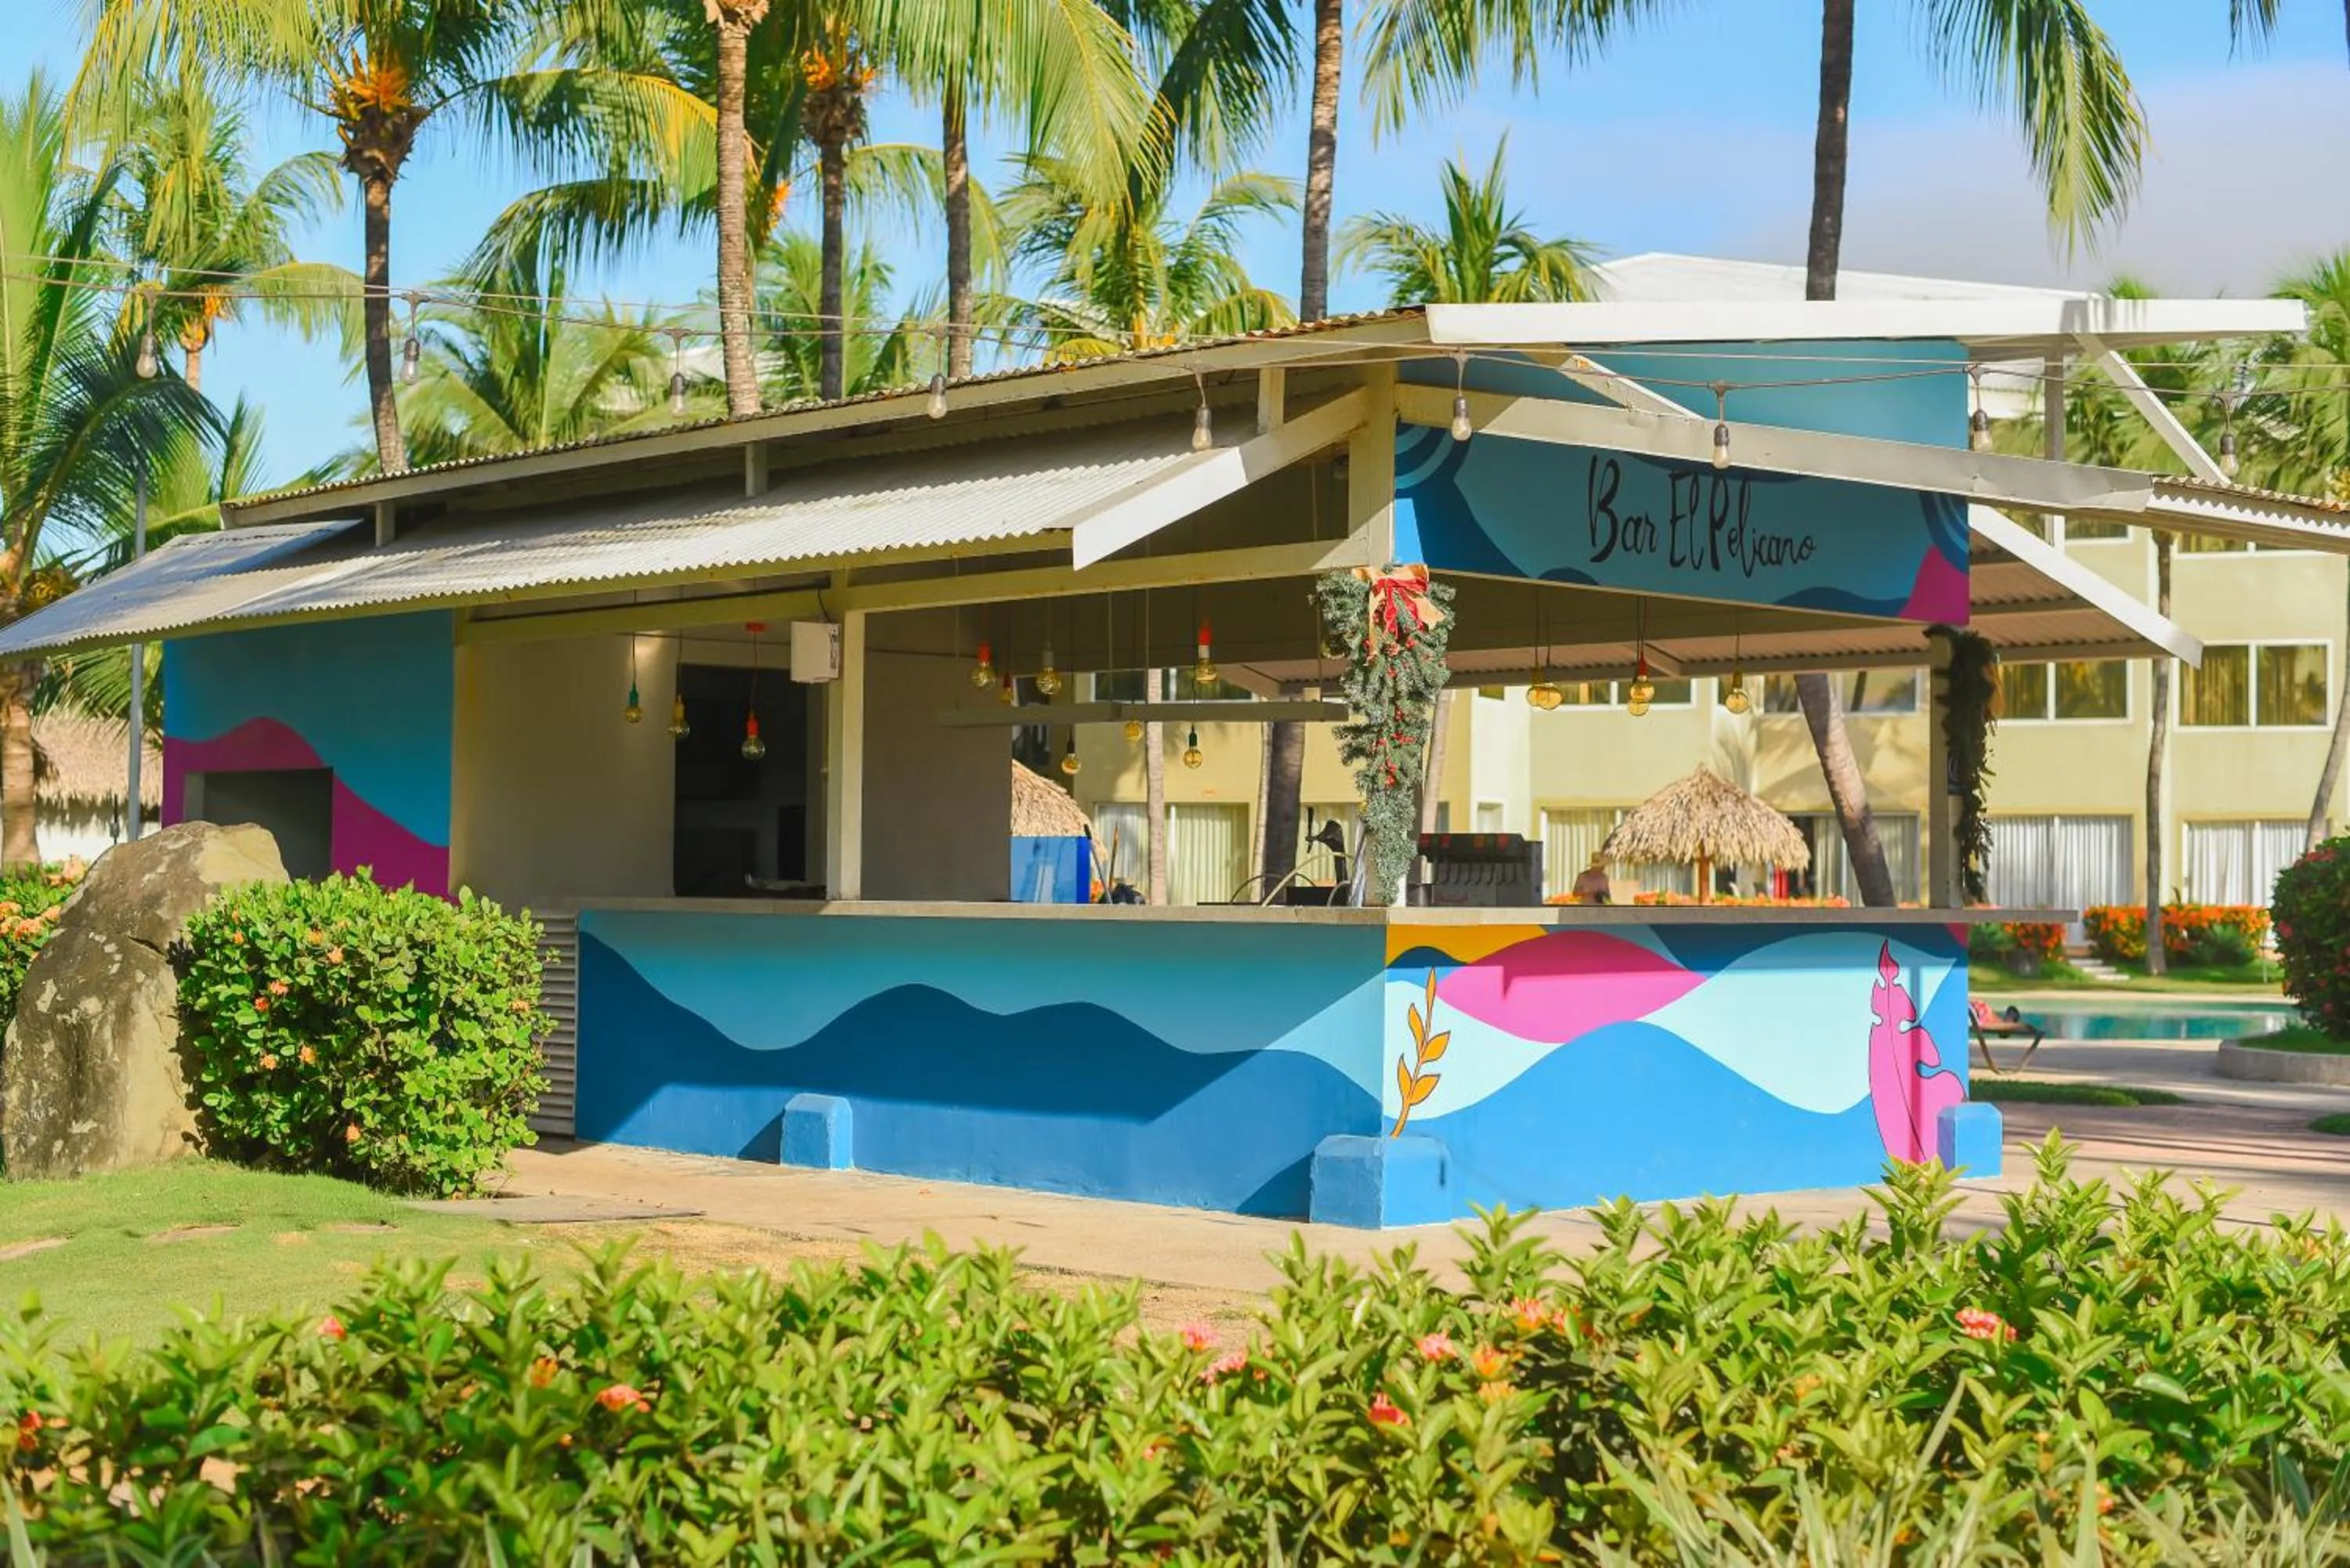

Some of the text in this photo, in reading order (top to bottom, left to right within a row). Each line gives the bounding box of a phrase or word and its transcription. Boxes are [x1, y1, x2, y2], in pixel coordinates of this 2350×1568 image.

[1589, 454, 1817, 578] Bar El Pelicano
